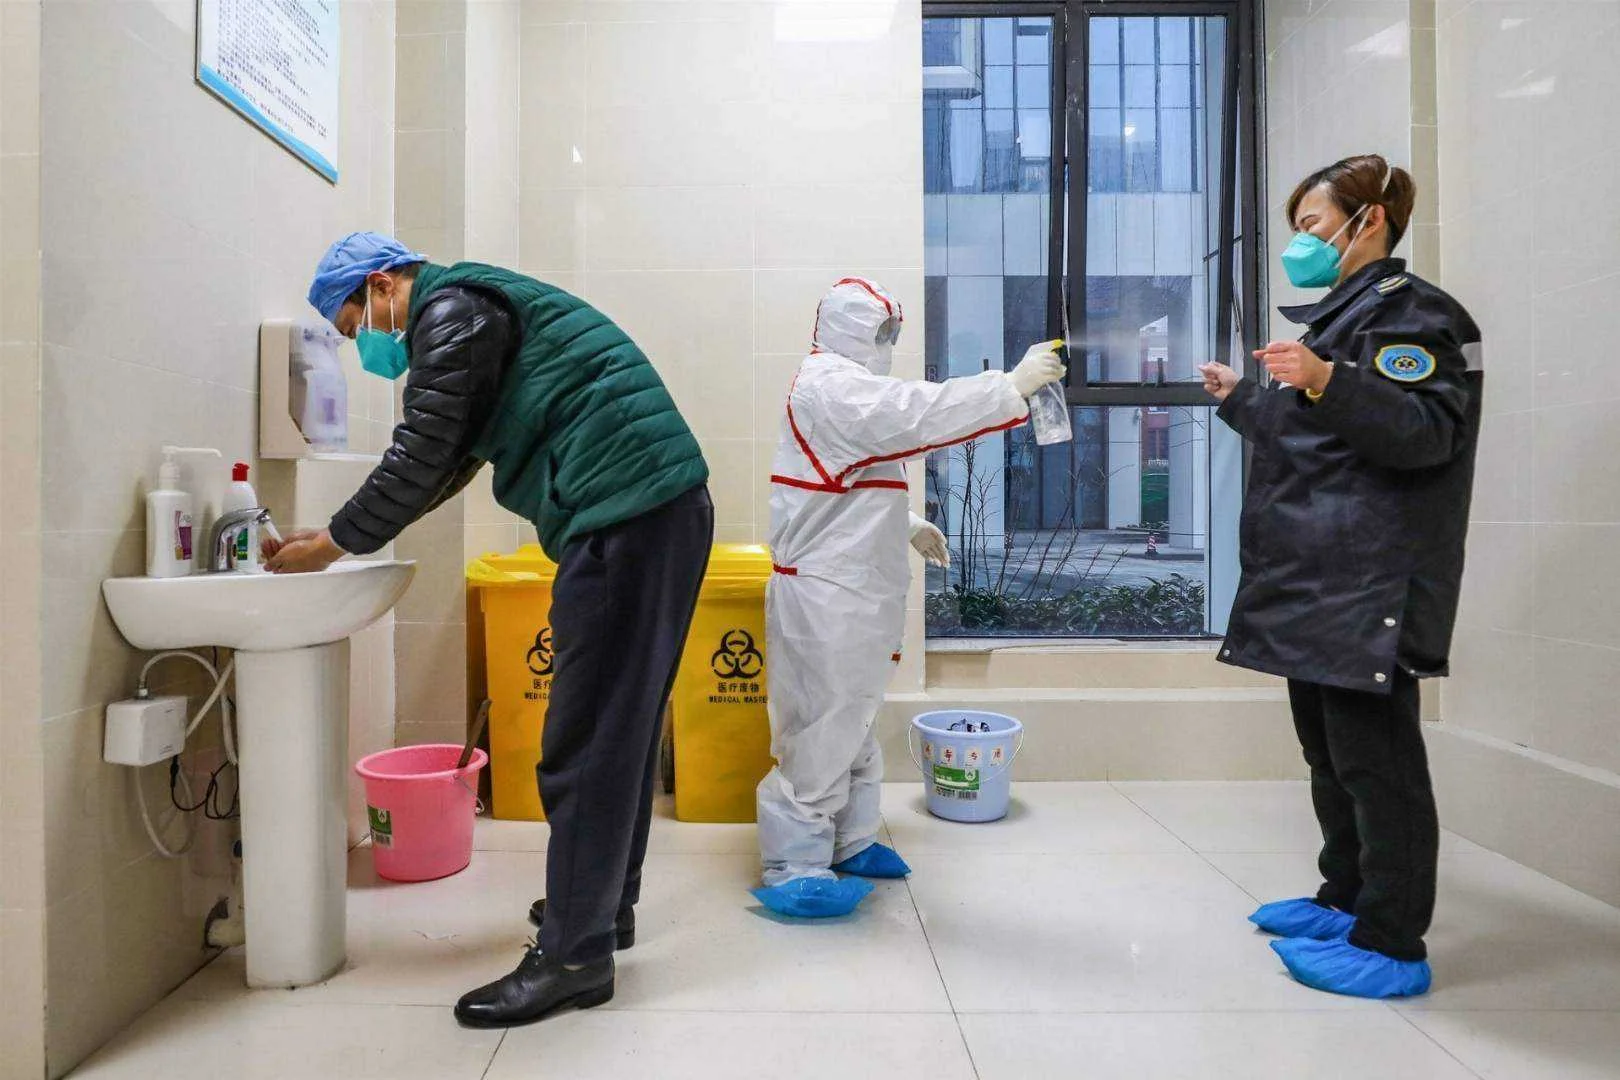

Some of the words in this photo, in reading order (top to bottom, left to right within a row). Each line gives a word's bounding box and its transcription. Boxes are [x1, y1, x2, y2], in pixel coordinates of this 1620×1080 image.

[718, 682, 760, 693] 医疗废物
[708, 695, 740, 704] MEDICAL
[743, 695, 768, 704] WASTE
